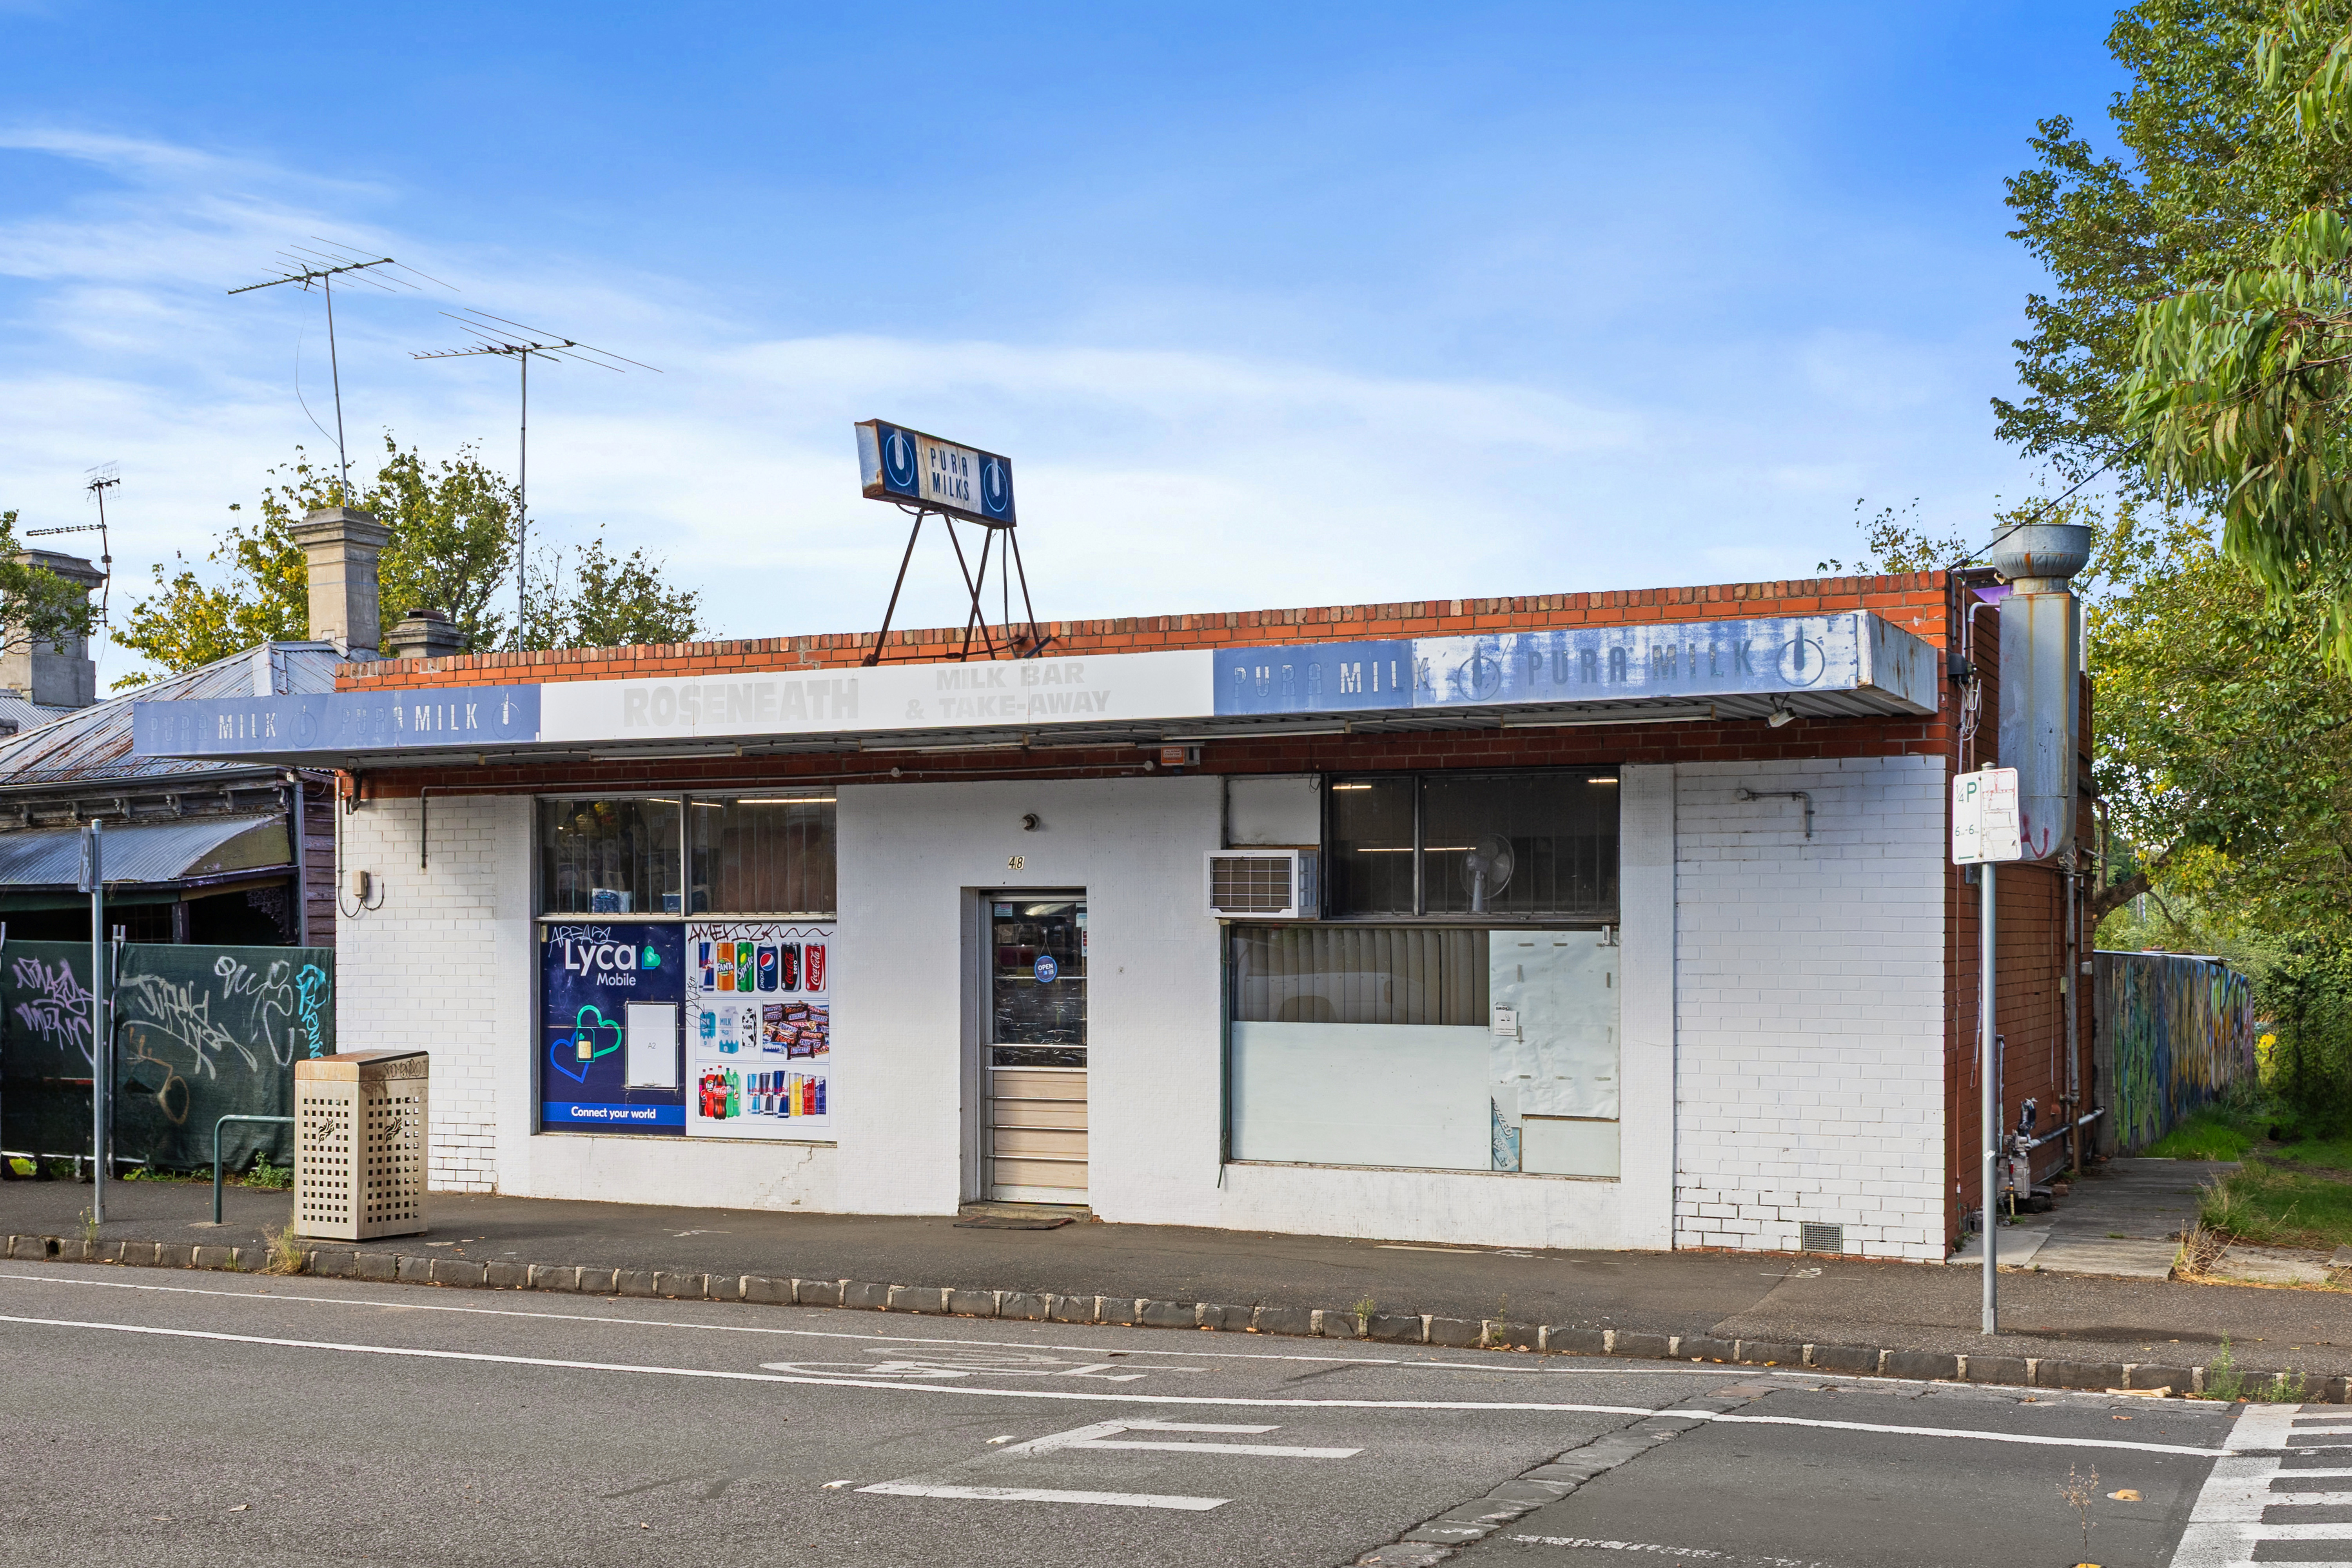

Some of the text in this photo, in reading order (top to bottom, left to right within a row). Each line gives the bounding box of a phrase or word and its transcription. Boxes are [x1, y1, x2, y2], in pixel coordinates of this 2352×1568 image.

[930, 448, 968, 477] PURA
[933, 472, 969, 501] MILKS
[936, 662, 1085, 691] MILK BAR
[1234, 657, 1431, 698] PURA MILK
[1528, 640, 1754, 686] PURA MILK
[624, 679, 858, 727] ROSENEATH
[905, 690, 1111, 720] & TAKE-AWAY
[150, 712, 276, 742] PURA MILK
[342, 703, 478, 735] PURA MILK
[1009, 857, 1023, 869] 48
[565, 939, 637, 976] Lyca
[717, 962, 734, 971] FANTA
[737, 956, 754, 980] Sprite
[597, 973, 636, 986] Mobile
[571, 1106, 656, 1120] Connect your world
